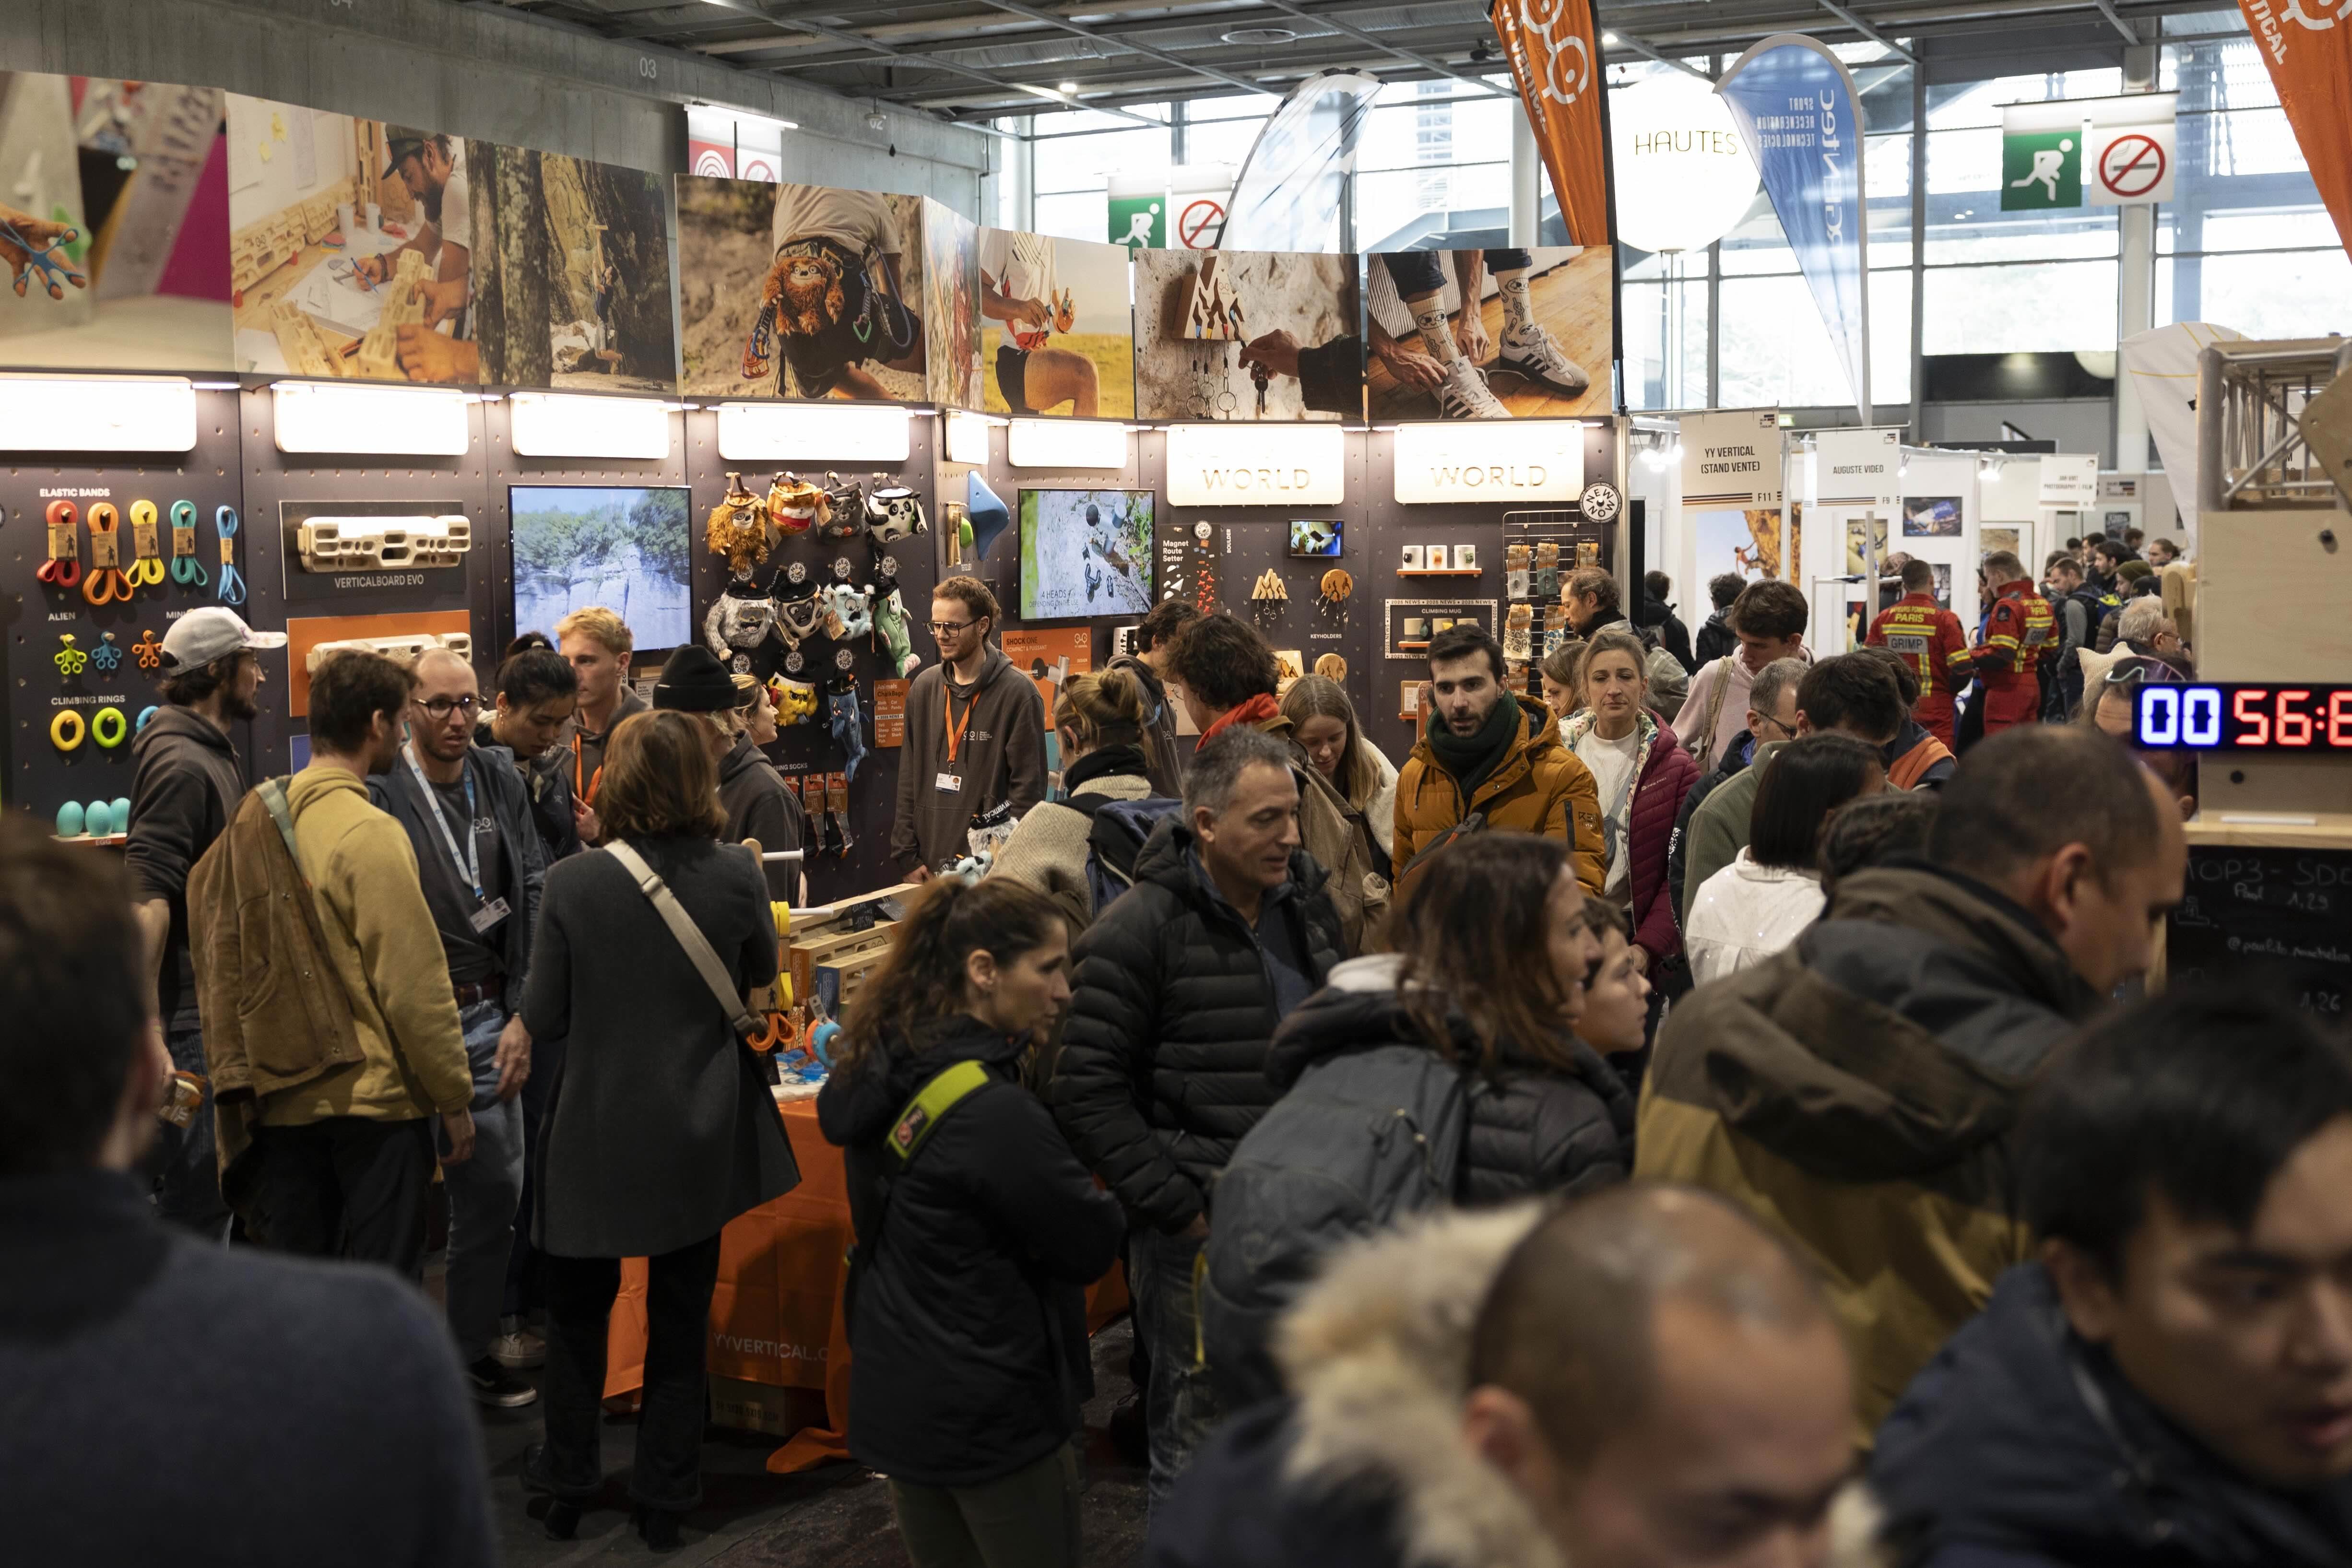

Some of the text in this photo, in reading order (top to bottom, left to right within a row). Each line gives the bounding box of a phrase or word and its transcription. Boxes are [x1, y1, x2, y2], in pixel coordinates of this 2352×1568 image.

[2246, 0, 2287, 65] TICAL
[639, 56, 657, 79] 03
[1635, 130, 1737, 155] HAUTES
[1705, 446, 1755, 458] YY VERTICAL
[1701, 461, 1760, 474] (STAND VENTE)
[1833, 465, 1884, 474] AUGUSTE VIDEO
[1202, 469, 1310, 490] WORLD
[1430, 467, 1547, 487] WORLD
[40, 488, 110, 497] ELASTIC BANDS
[1758, 493, 1771, 502] F11
[1586, 489, 1615, 518] NEW NOW
[791, 564, 804, 581] NEW NOW
[836, 559, 849, 578] NEW NOW
[883, 558, 896, 575] NEW NOW
[334, 575, 424, 589] VERTICALBOARD EVO
[1047, 590, 1066, 599] HEADS
[48, 612, 76, 621] ALIEN
[166, 611, 185, 619] MIN
[1894, 613, 1925, 623] PARIS
[1891, 638, 1923, 649] GRIMP
[735, 656, 749, 672] NEW NOW
[787, 652, 802, 671] NEW NOW
[838, 649, 851, 669] NEW NOW
[51, 694, 125, 705] CLIMBING RINGS
[2140, 687, 2221, 745] 00
[982, 804, 1006, 820] VERTICAL
